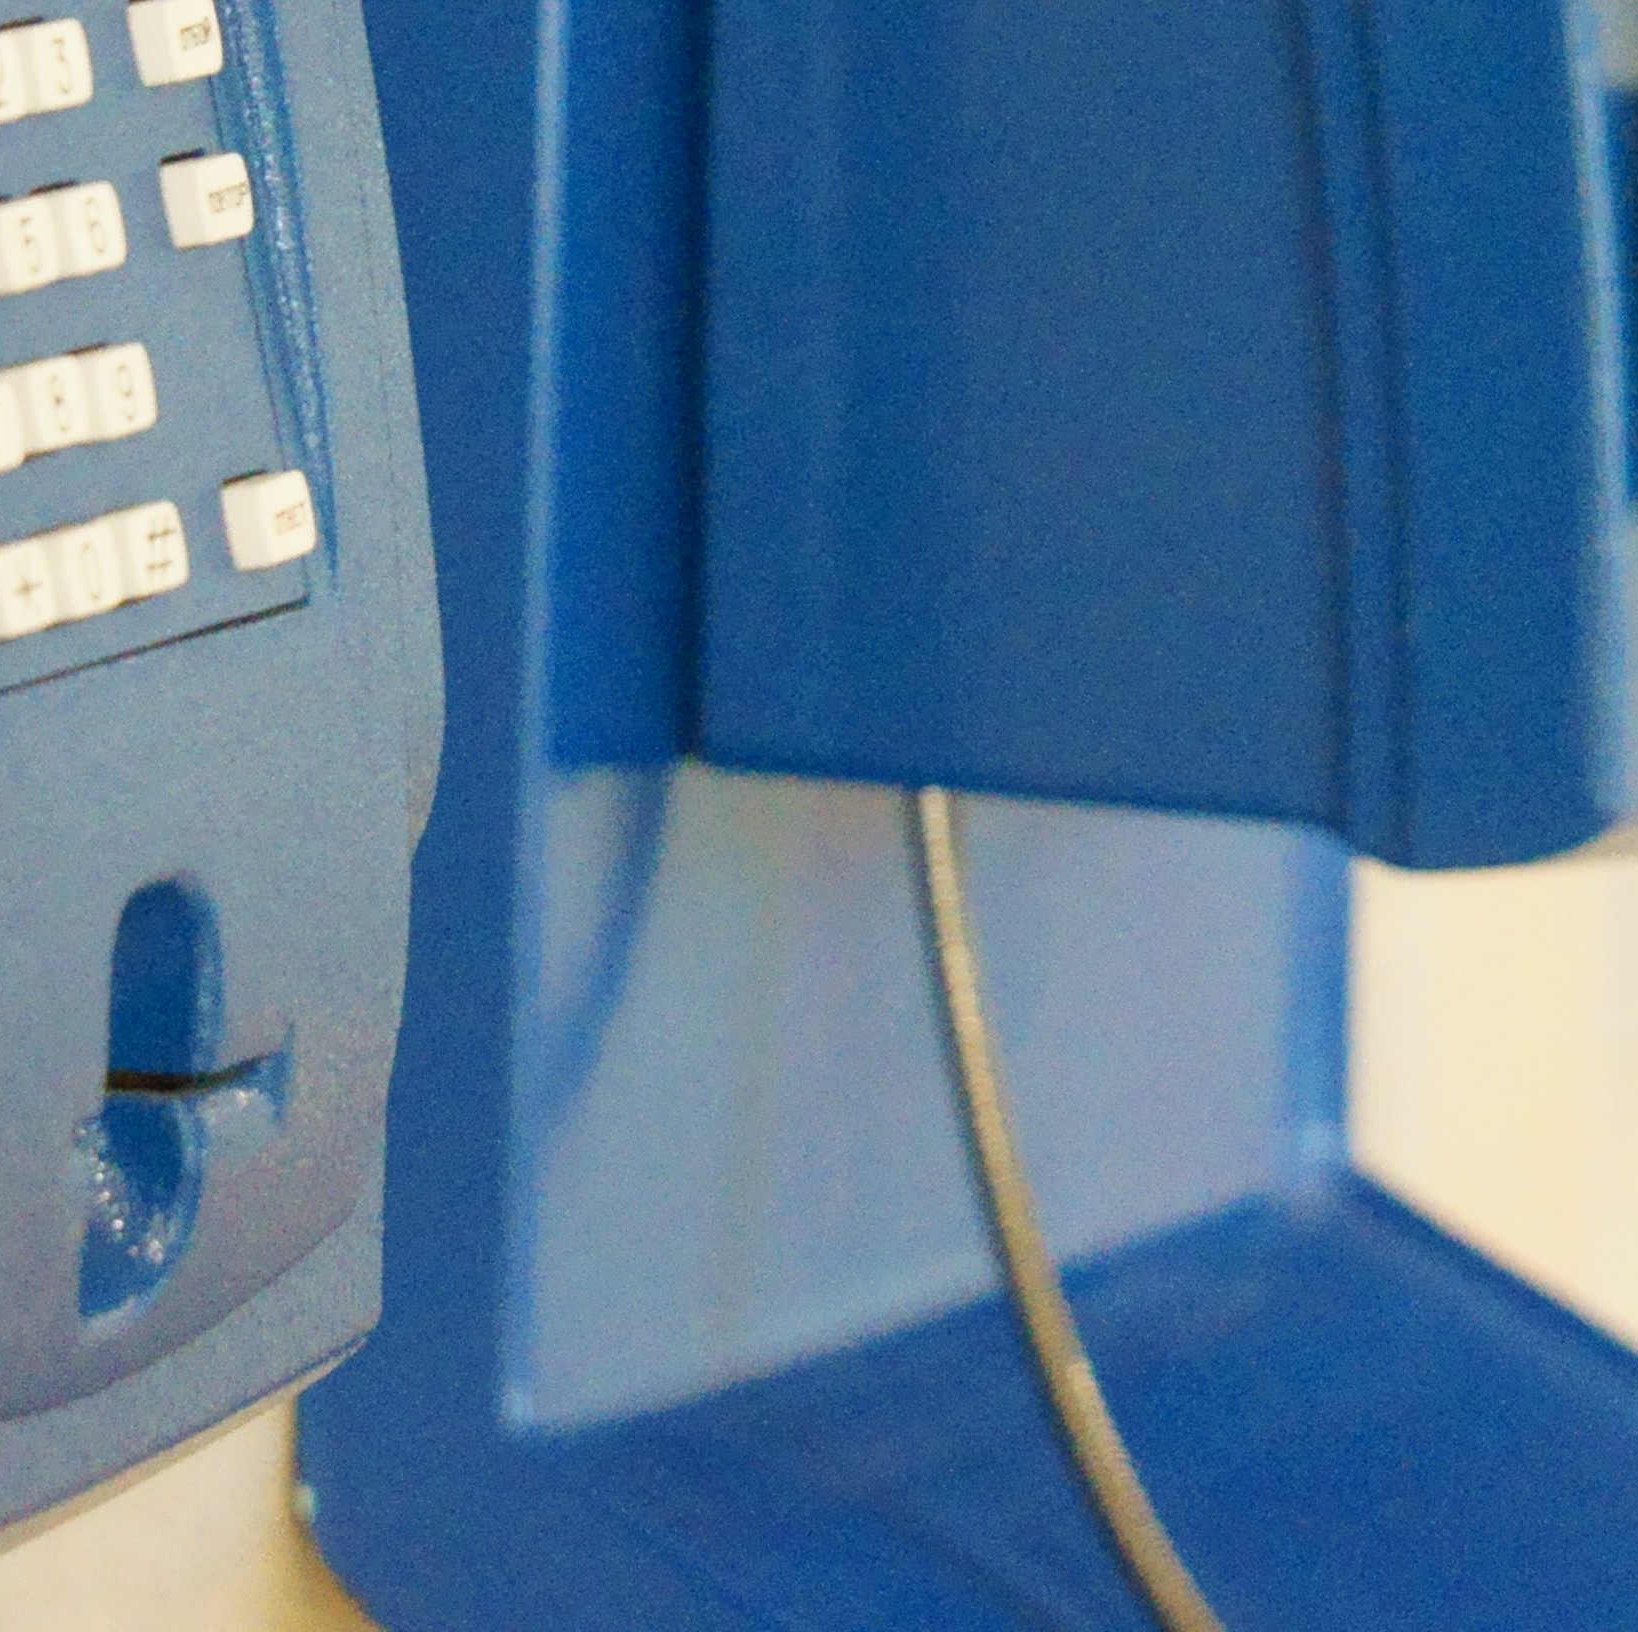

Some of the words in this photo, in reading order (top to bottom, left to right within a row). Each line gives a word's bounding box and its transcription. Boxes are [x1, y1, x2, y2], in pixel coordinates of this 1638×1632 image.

[50, 37, 74, 96] 3
[19, 216, 43, 274] 5
[83, 196, 108, 255] 6
[48, 374, 72, 434] 8
[116, 363, 138, 422] 9
[80, 541, 104, 603] 0
